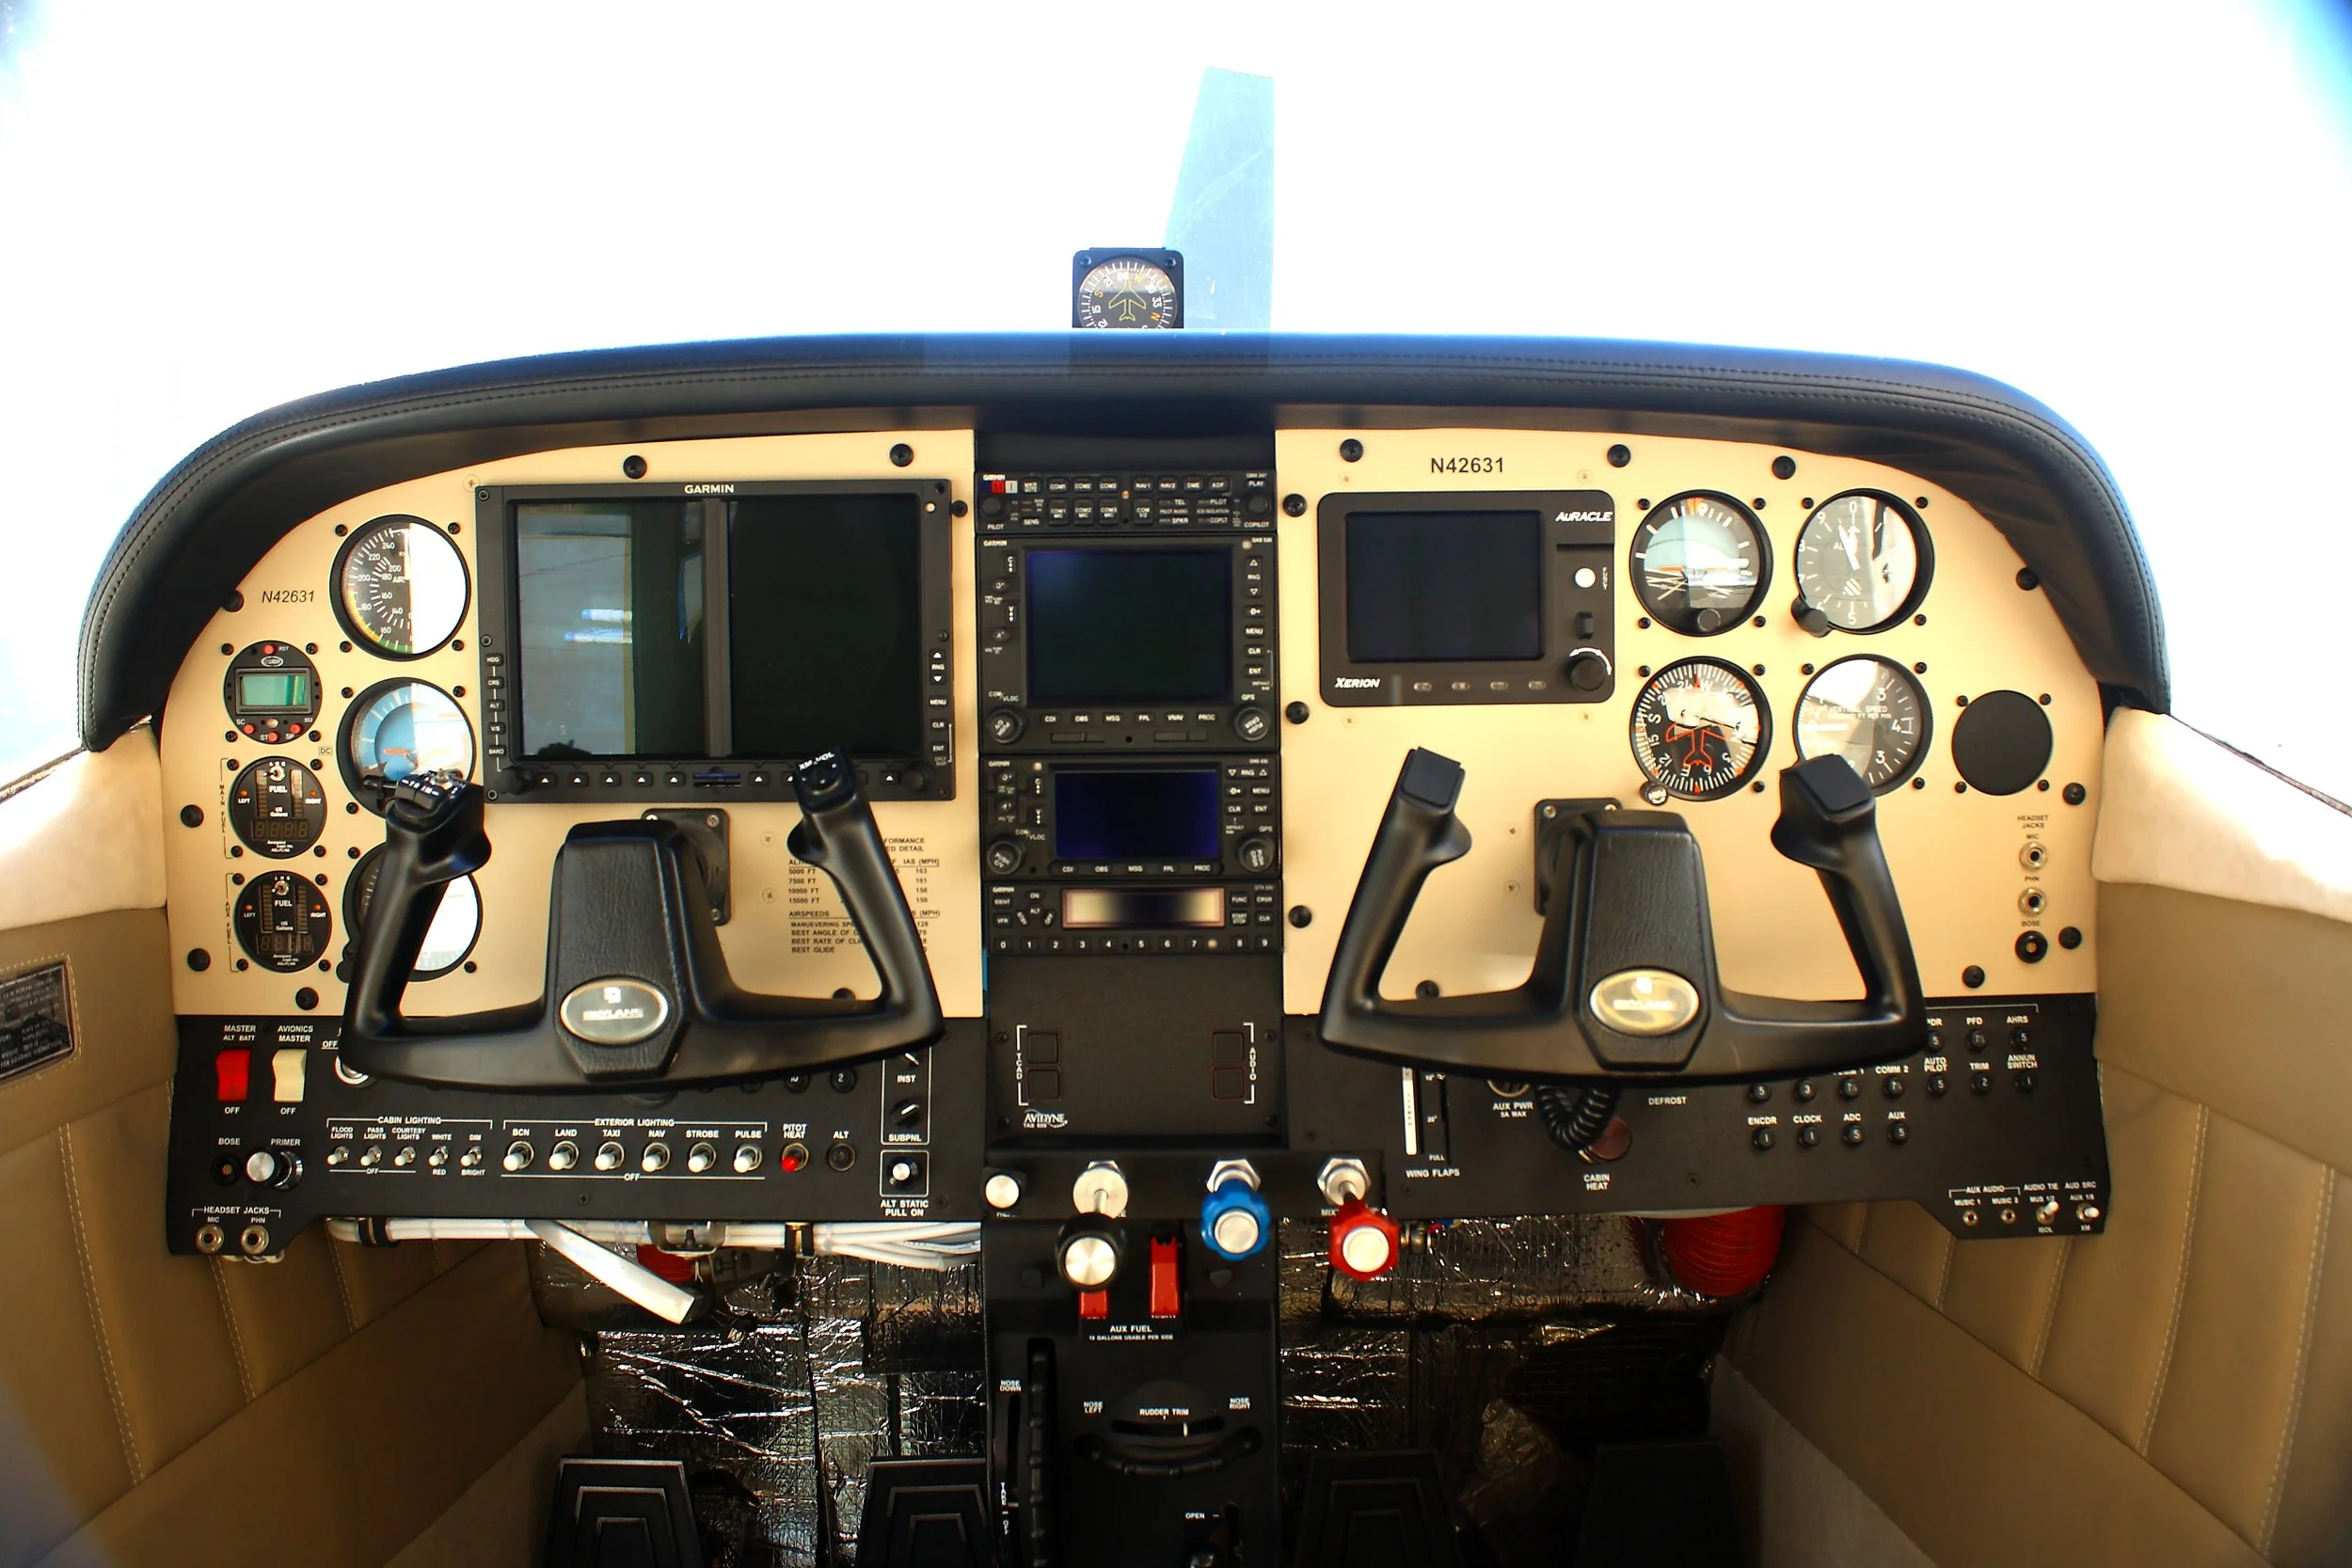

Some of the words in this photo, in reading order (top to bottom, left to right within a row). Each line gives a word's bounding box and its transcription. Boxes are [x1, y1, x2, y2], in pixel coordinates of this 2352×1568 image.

[1151, 311, 1161, 322] N
[1430, 457, 1505, 473] N42631
[684, 483, 735, 495] GARMIN
[1849, 500, 1858, 514] 0
[382, 542, 395, 550] 240
[261, 590, 316, 604] N42631
[1847, 611, 1856, 625] 5
[1335, 677, 1381, 689] XERION
[1876, 687, 1886, 701] 3
[1648, 713, 1661, 724] S
[1891, 719, 1901, 732] 4
[1875, 750, 1885, 764] 3
[1680, 764, 1692, 778] E
[1966, 1017, 1983, 1025] PFD
[2006, 1016, 2028, 1024] AHRS
[224, 1024, 256, 1033] MASTER
[277, 1024, 313, 1033] AVIONICS
[1925, 1056, 1947, 1065] AUTO
[2007, 1061, 2038, 1069] SWITCH
[1875, 1066, 1901, 1074] COMM
[1924, 1064, 1947, 1072] PILOT
[1969, 1062, 1990, 1070] TRIM
[897, 1074, 915, 1083] INST
[1648, 1096, 1687, 1106] DEFROST
[1493, 1102, 1511, 1111] AUX
[1513, 1101, 1534, 1110] PWR
[1793, 1115, 1822, 1124] CLOCK
[1843, 1113, 1861, 1121] ADC
[1887, 1112, 1905, 1120] AUX
[405, 1117, 442, 1125] LIGHTING
[595, 1118, 635, 1127] EXTERIOR
[637, 1118, 675, 1127] LIGHTING
[1747, 1117, 1777, 1126] ENCDR
[783, 1123, 807, 1132] PITOT
[784, 1131, 806, 1139] HEAT
[833, 1131, 850, 1139] ALT
[888, 1133, 922, 1142] SUBPNL
[218, 1137, 241, 1146] BOSE
[624, 1173, 641, 1181] OFF
[1432, 1168, 1460, 1177] FLAPS
[1583, 1173, 1611, 1182] CABIN
[1586, 1181, 1609, 1191] HEAT
[881, 1199, 897, 1208] ALT
[899, 1199, 929, 1208] STATIC
[203, 1206, 241, 1214] HEADSET
[884, 1208, 907, 1216] PULL
[911, 1208, 924, 1216] ON
